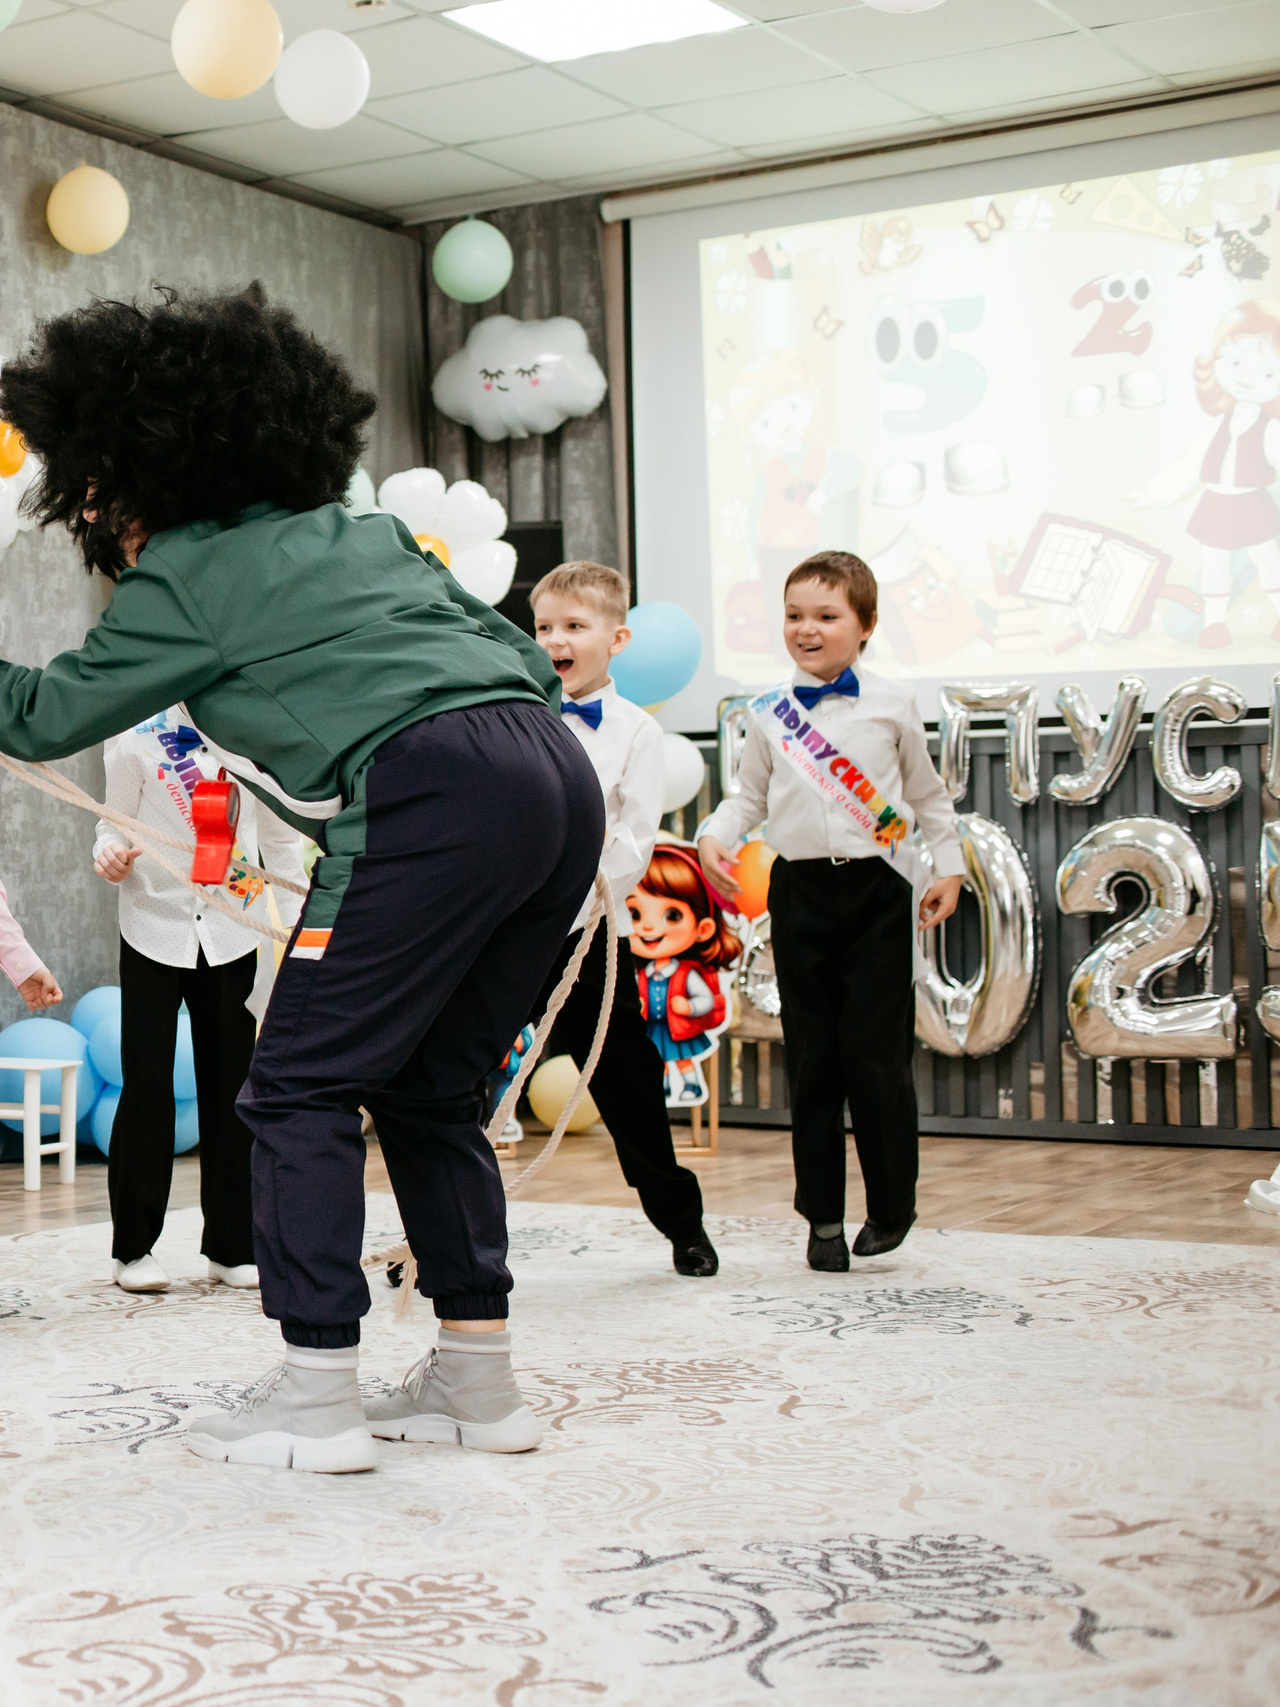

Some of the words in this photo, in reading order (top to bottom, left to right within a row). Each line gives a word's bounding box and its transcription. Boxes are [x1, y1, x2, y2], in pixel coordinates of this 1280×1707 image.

[773, 697, 898, 828] ВЫПУСКНИК
[792, 747, 847, 803] детского
[844, 802, 873, 830] сада
[166, 781, 197, 838] детск
